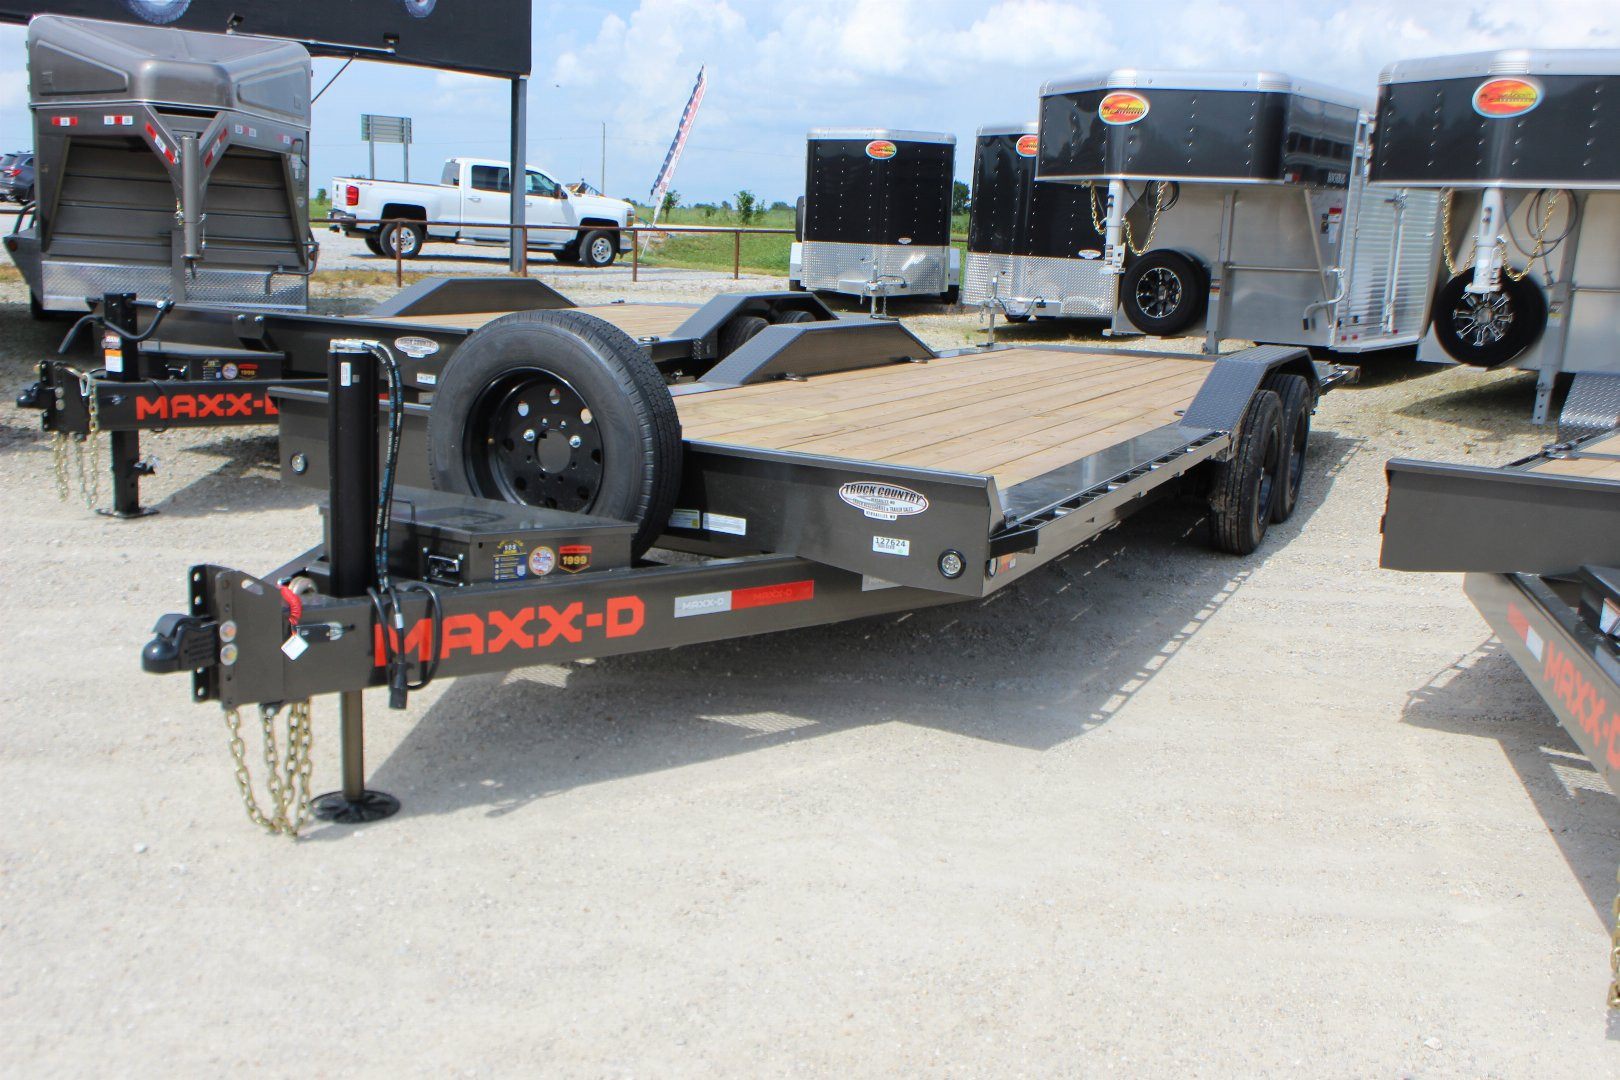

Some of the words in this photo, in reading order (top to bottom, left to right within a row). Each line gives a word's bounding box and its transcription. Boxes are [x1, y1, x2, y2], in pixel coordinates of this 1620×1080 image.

[844, 484, 876, 495] TRUCK
[877, 487, 923, 504] COUNTRY
[875, 537, 906, 547] 127624
[562, 555, 588, 565] 1999
[681, 596, 724, 611] MAXX-D
[374, 595, 645, 667] MAXX-D
